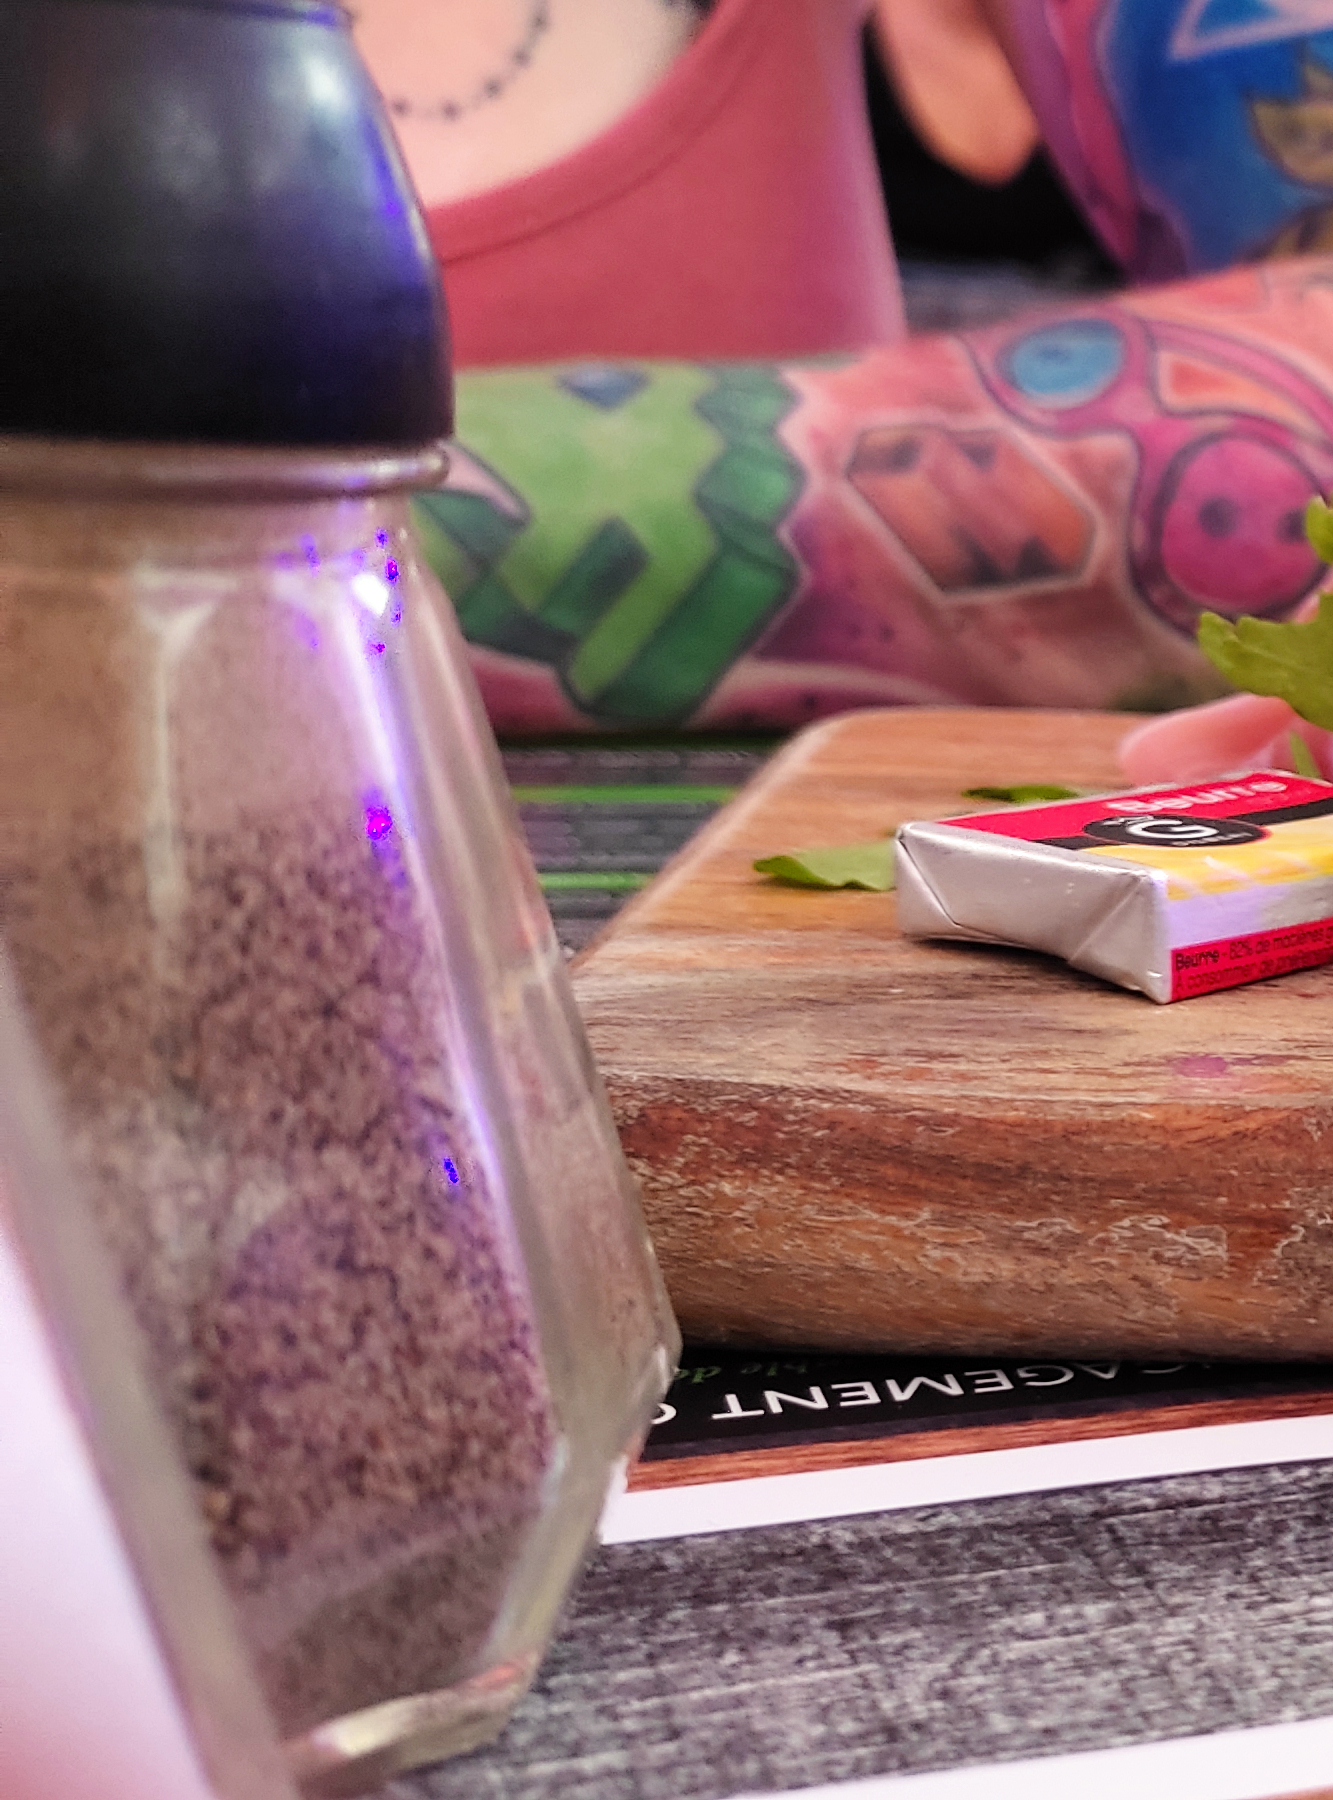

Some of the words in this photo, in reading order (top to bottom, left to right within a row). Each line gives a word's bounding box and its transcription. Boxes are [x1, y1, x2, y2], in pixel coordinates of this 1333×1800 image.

[1106, 780, 1288, 814] Beurre
[1126, 818, 1219, 839] G
[1175, 946, 1220, 972] Beurre
[710, 1361, 1190, 1420] AGEMENT
